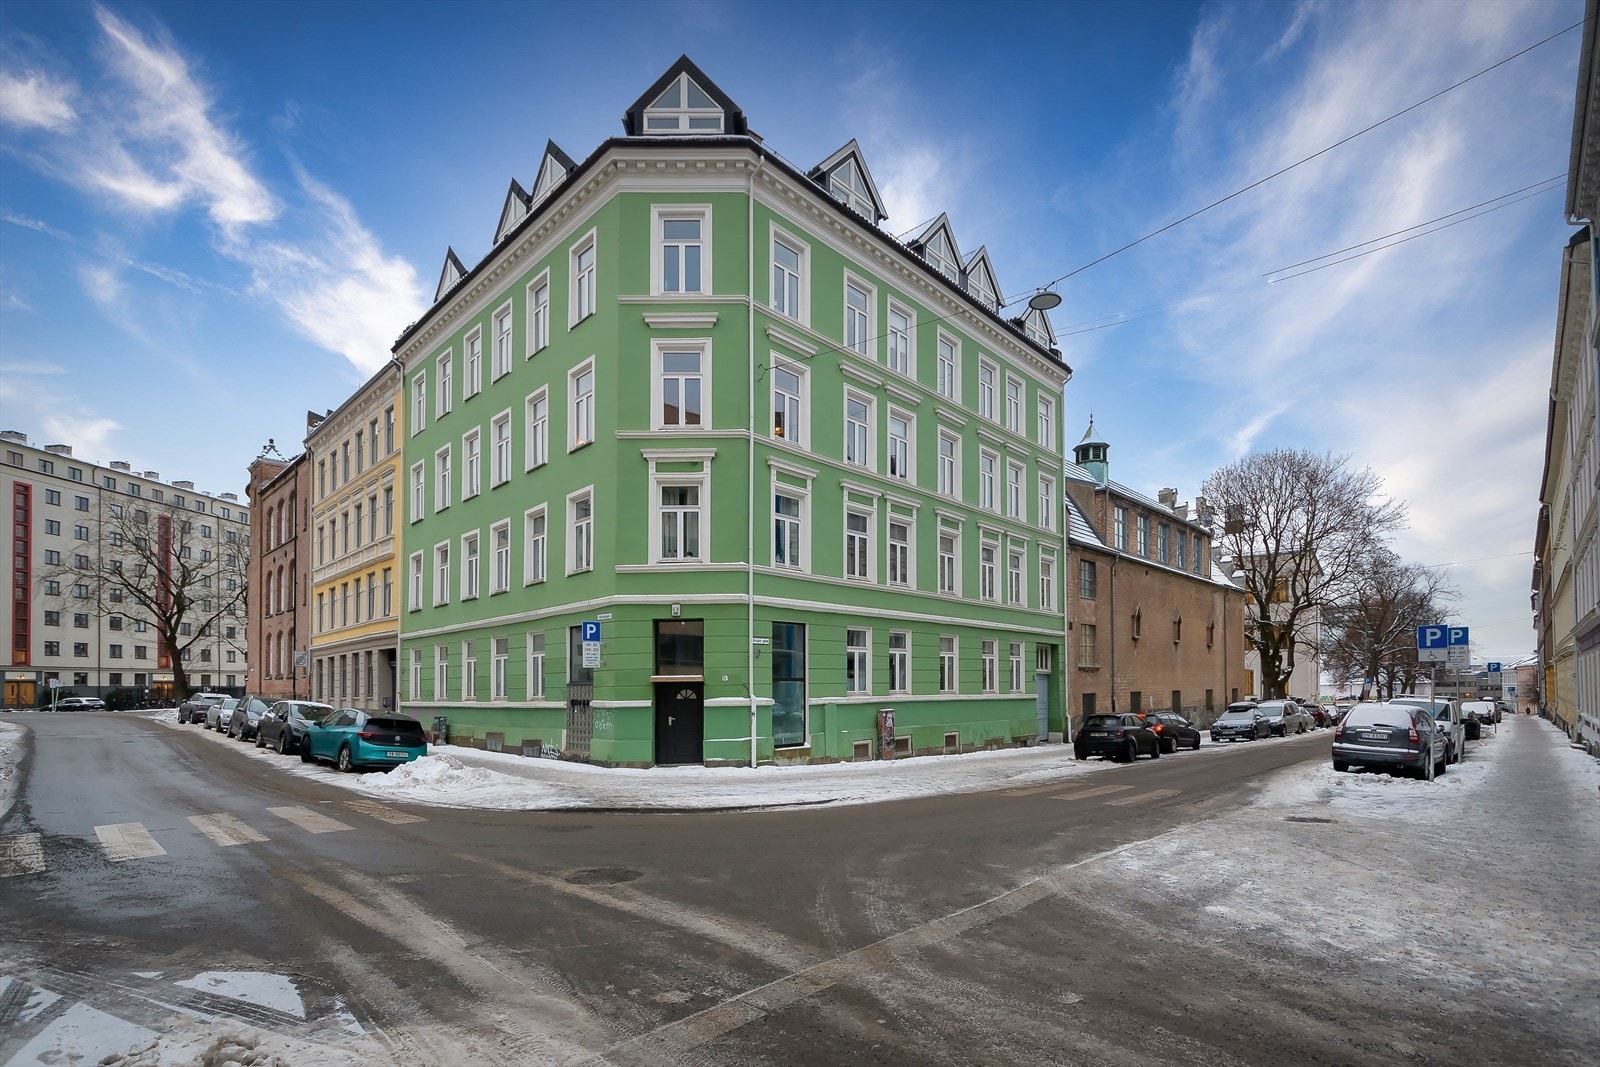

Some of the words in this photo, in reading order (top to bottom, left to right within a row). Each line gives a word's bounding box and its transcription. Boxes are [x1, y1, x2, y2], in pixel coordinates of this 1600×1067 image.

[586, 623, 597, 640] P
[1425, 628, 1442, 647] P
[1450, 629, 1464, 644] P
[1490, 663, 1498, 672] P
